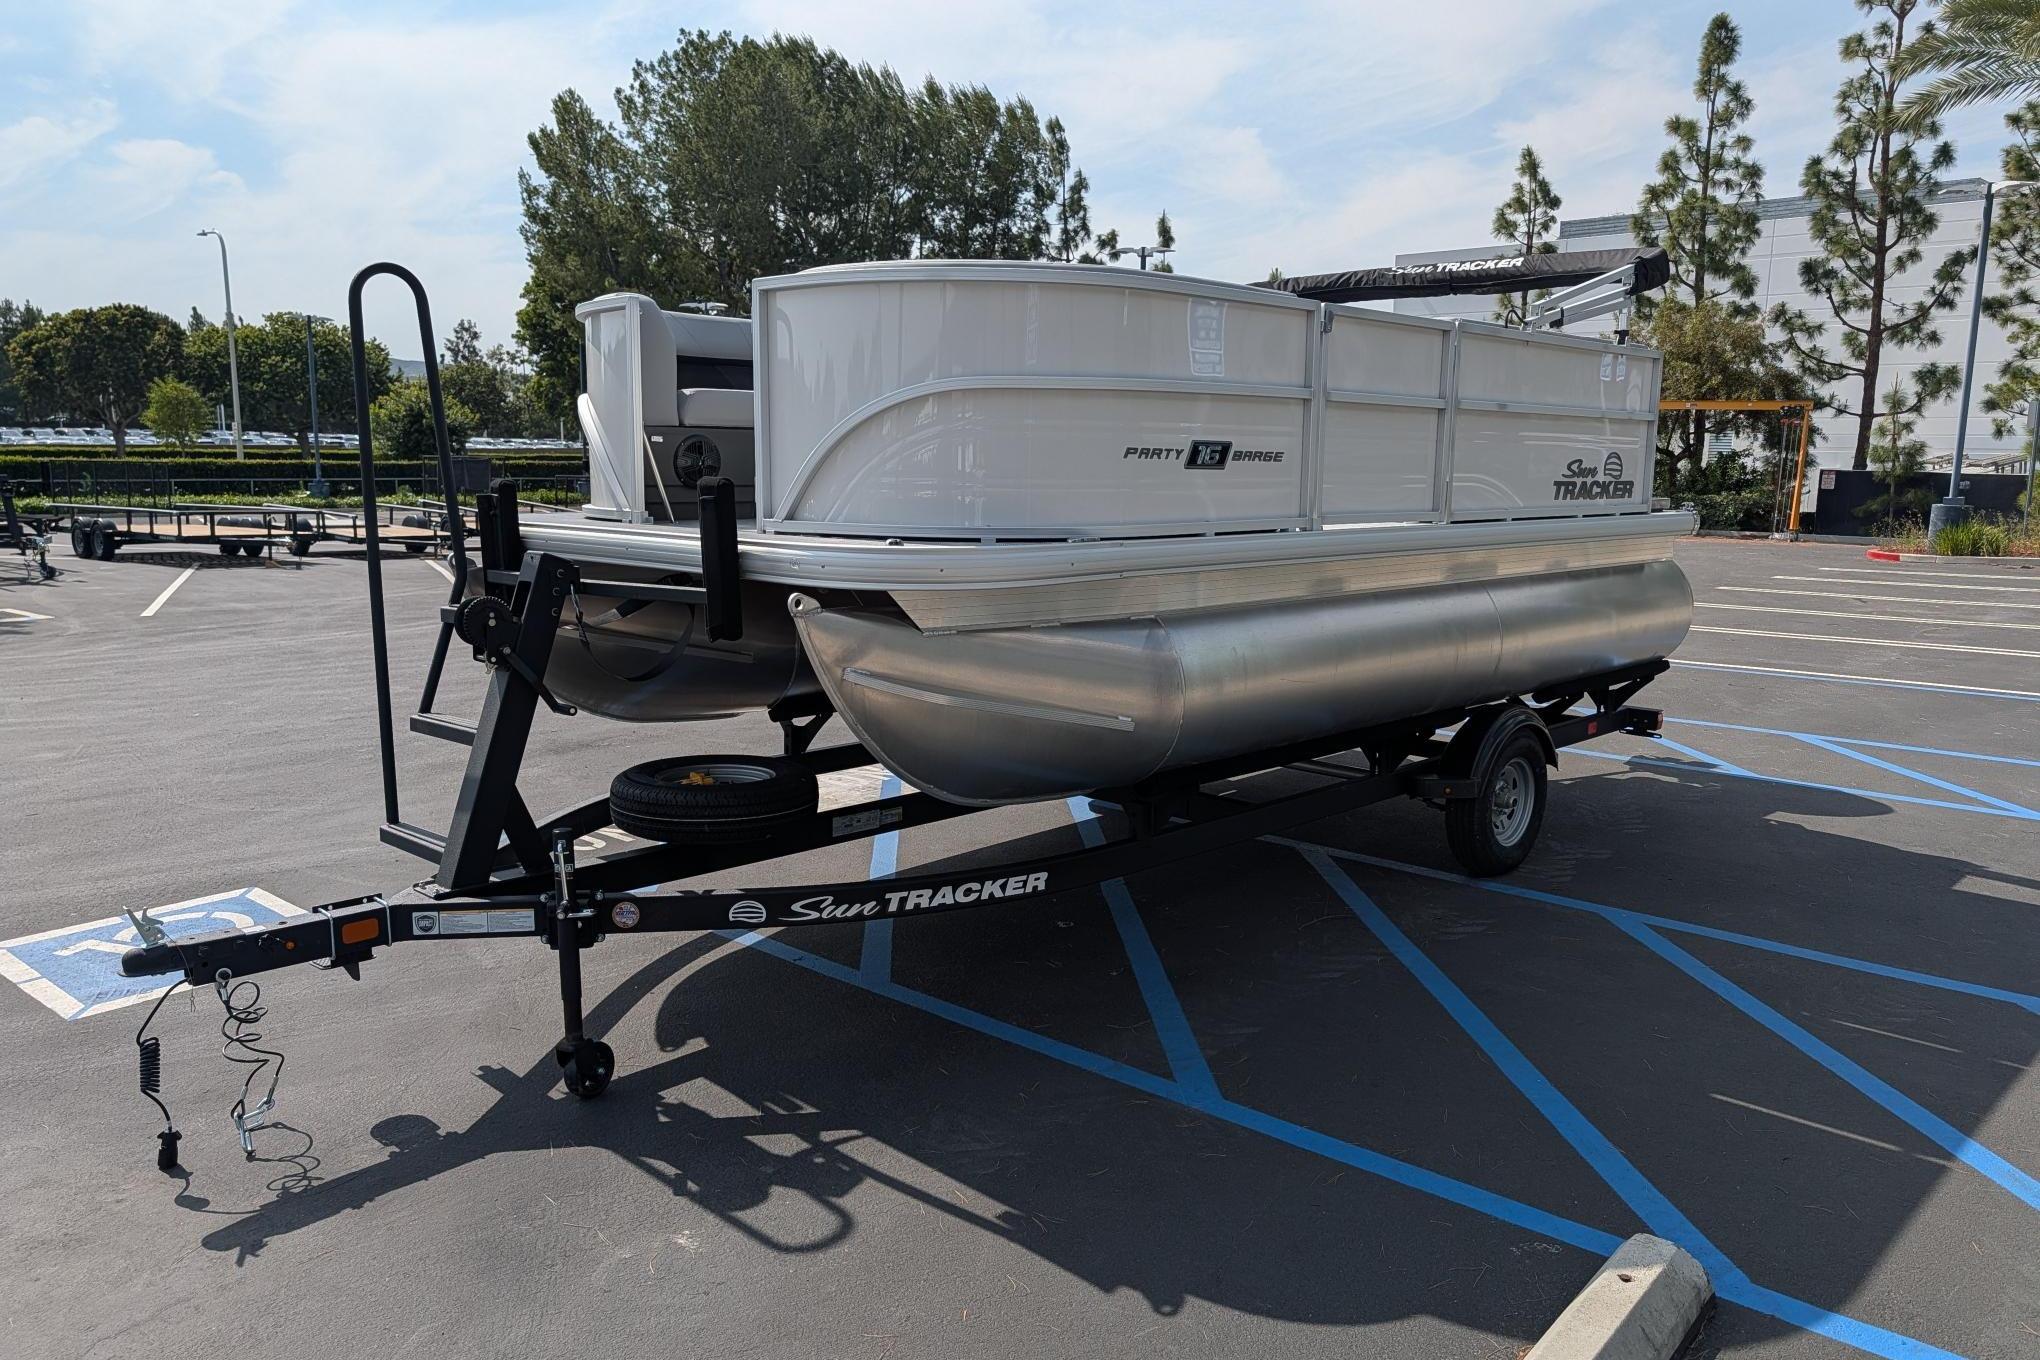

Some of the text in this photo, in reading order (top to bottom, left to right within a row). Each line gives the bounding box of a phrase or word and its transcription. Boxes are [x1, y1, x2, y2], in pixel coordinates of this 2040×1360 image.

[1436, 257, 1524, 273] TRACKER
[1123, 446, 1285, 465] PARTY 16 BARGE
[1561, 458, 1599, 479] Sun
[1552, 480, 1634, 501] TRACKER
[777, 871, 1049, 922] Sun TRACKER
